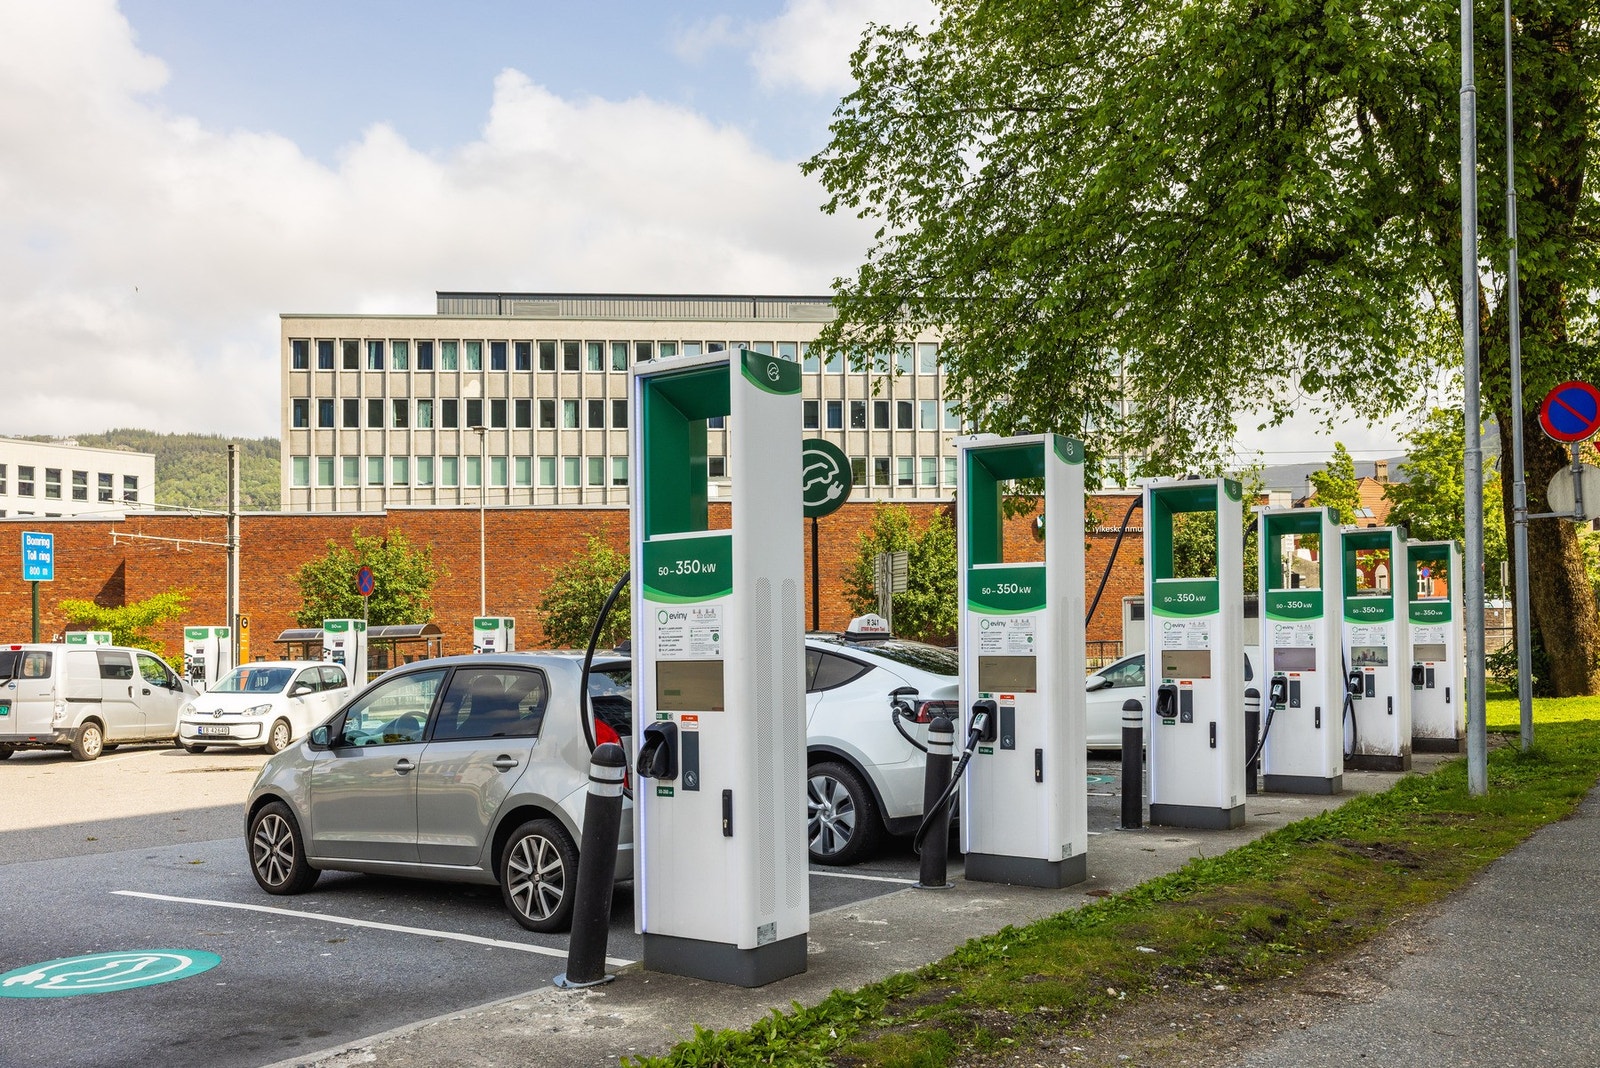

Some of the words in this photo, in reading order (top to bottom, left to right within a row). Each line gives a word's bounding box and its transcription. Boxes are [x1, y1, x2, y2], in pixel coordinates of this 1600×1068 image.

[26, 535, 50, 549] Bomring
[26, 550, 37, 560] Toll
[38, 550, 50, 564] ring
[30, 566, 40, 576] 800
[702, 564, 716, 573] kW
[669, 611, 687, 620] eviny
